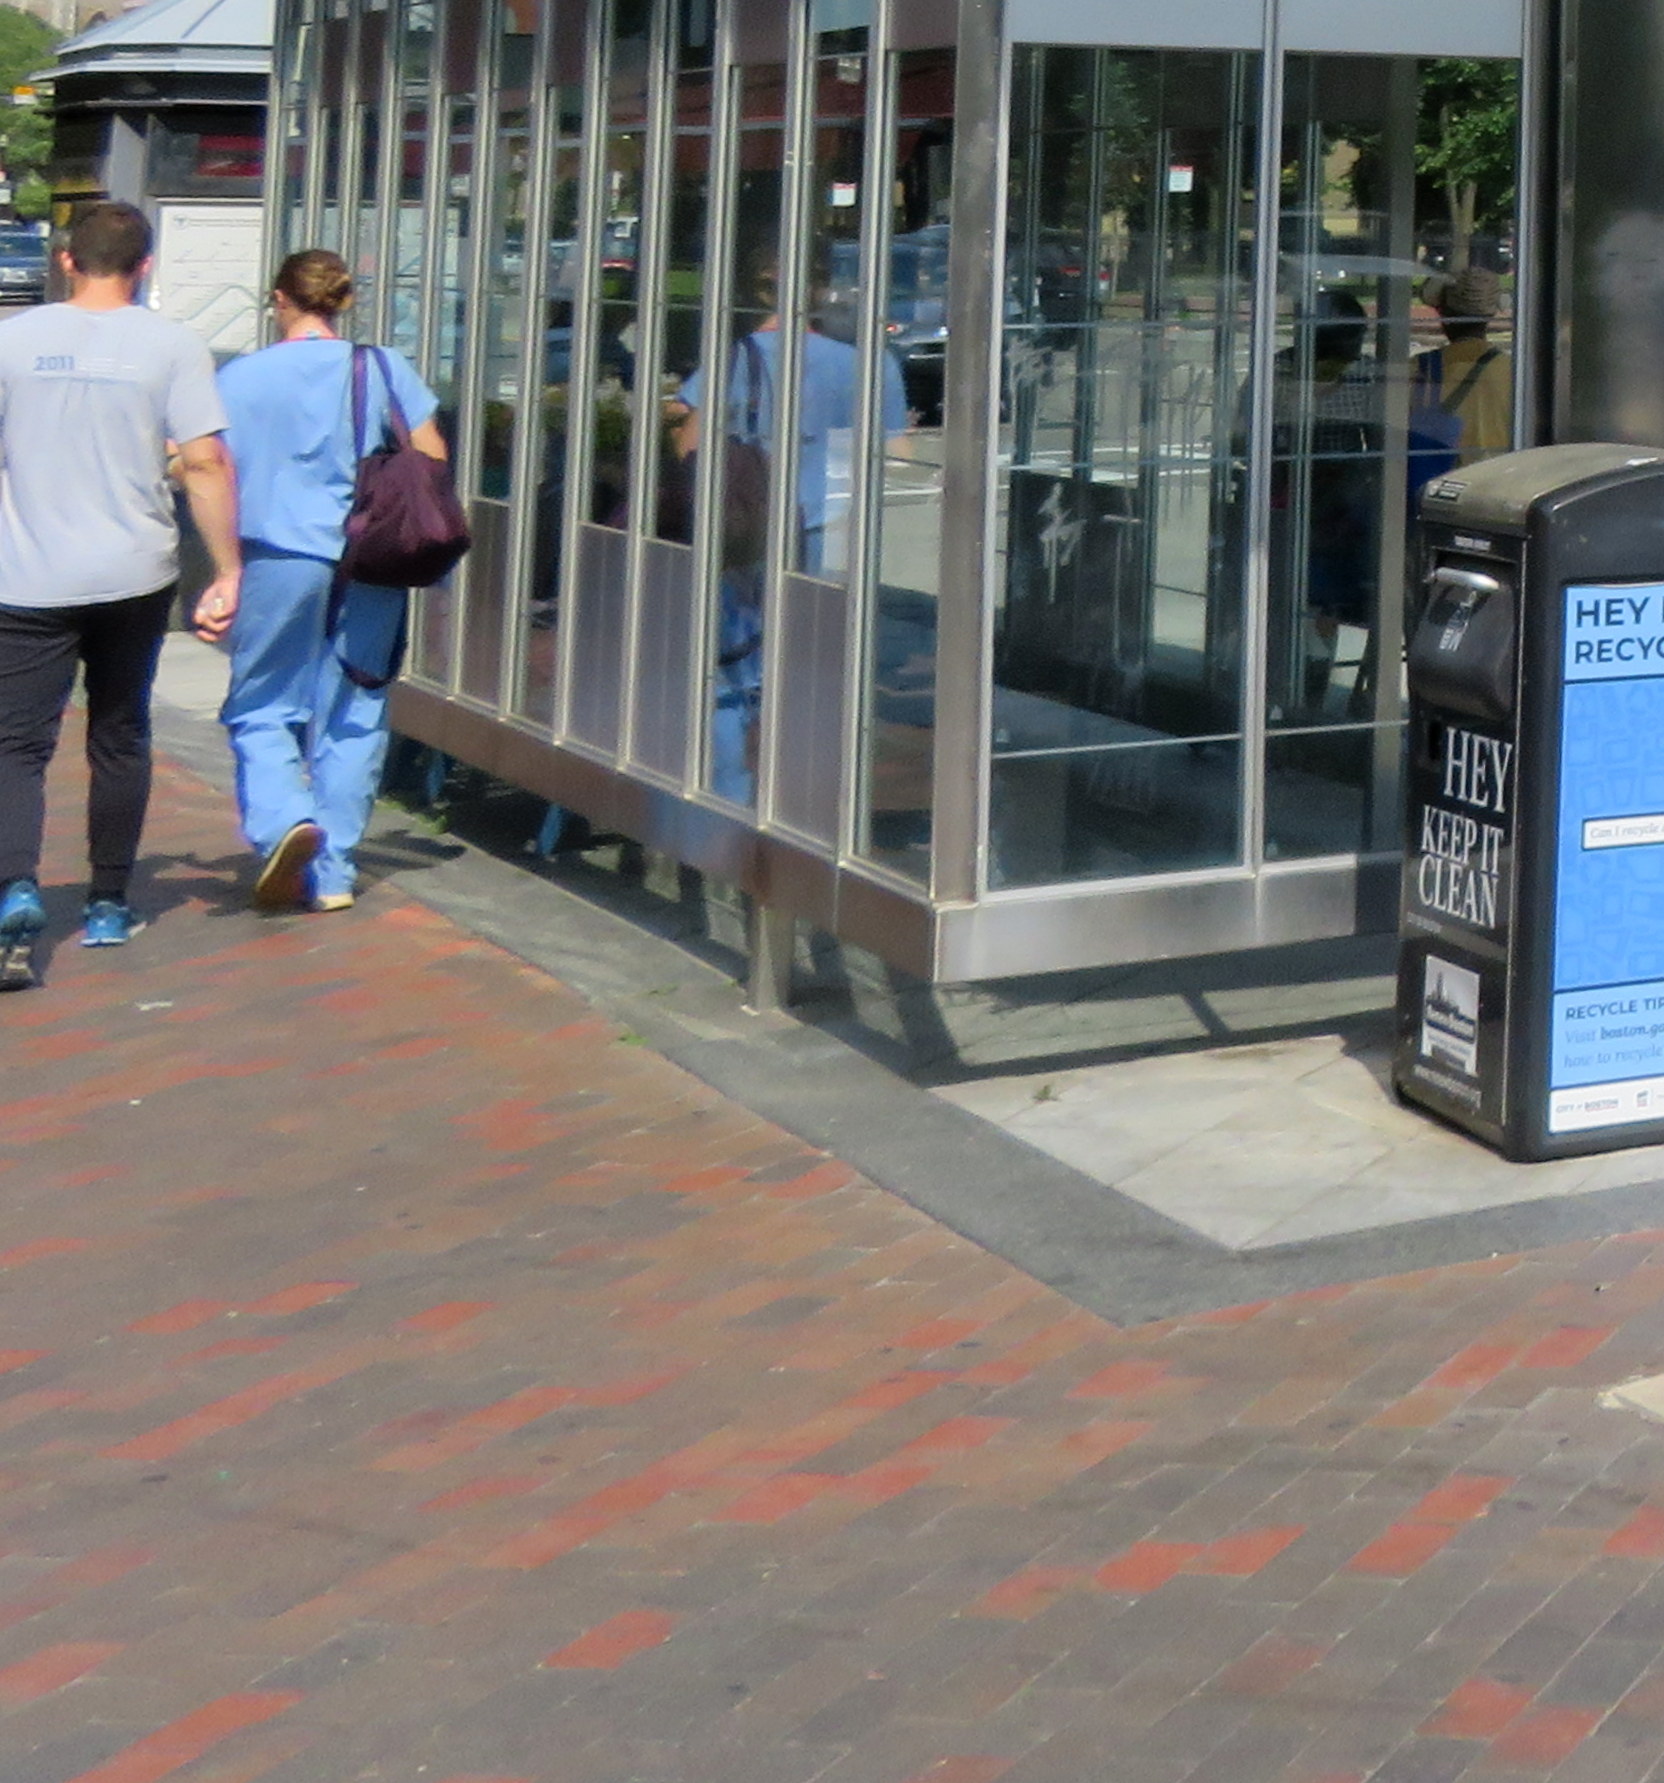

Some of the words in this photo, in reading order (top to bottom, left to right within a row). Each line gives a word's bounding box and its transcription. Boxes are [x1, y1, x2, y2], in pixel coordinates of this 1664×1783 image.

[1576, 596, 1650, 628] HEY
[1443, 726, 1513, 813] HEY
[1421, 804, 1477, 866] KEEP
[1481, 823, 1504, 874] IT
[1590, 827, 1612, 839] Can
[1621, 823, 1658, 841] recycle
[1419, 854, 1499, 929] CLEAN
[1565, 999, 1638, 1021] RECYCLE
[1565, 1028, 1598, 1045] Visit
[1564, 1054, 1594, 1068] how
[1597, 1052, 1611, 1064] to
[1614, 1046, 1664, 1066] recycle
[1556, 1104, 1575, 1114] CITY
[1585, 1099, 1619, 1110] BOSTON
